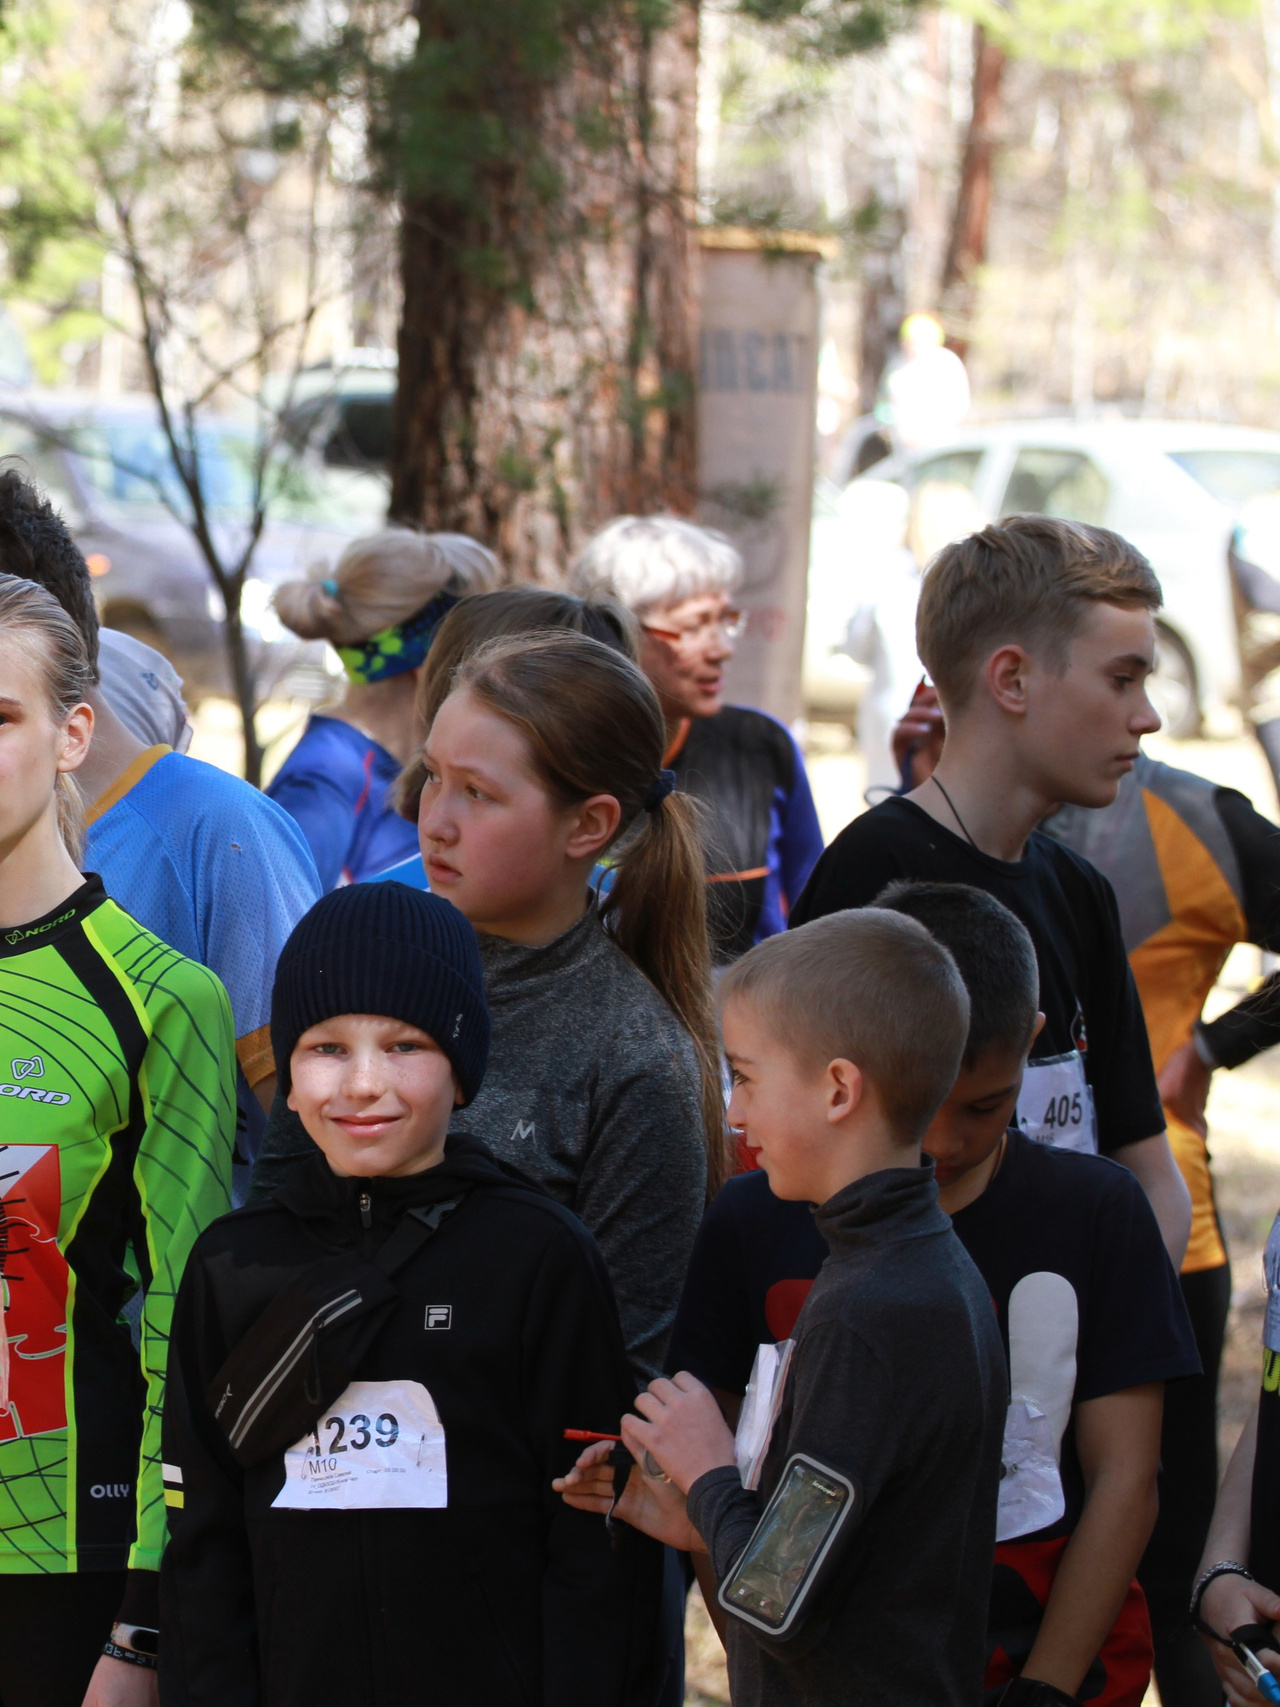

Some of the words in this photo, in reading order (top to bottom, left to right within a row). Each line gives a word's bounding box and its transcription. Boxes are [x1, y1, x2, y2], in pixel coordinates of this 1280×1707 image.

[25, 908, 76, 937] NORD
[1043, 1092, 1082, 1129] 405
[90, 1484, 130, 1499] OLLY
